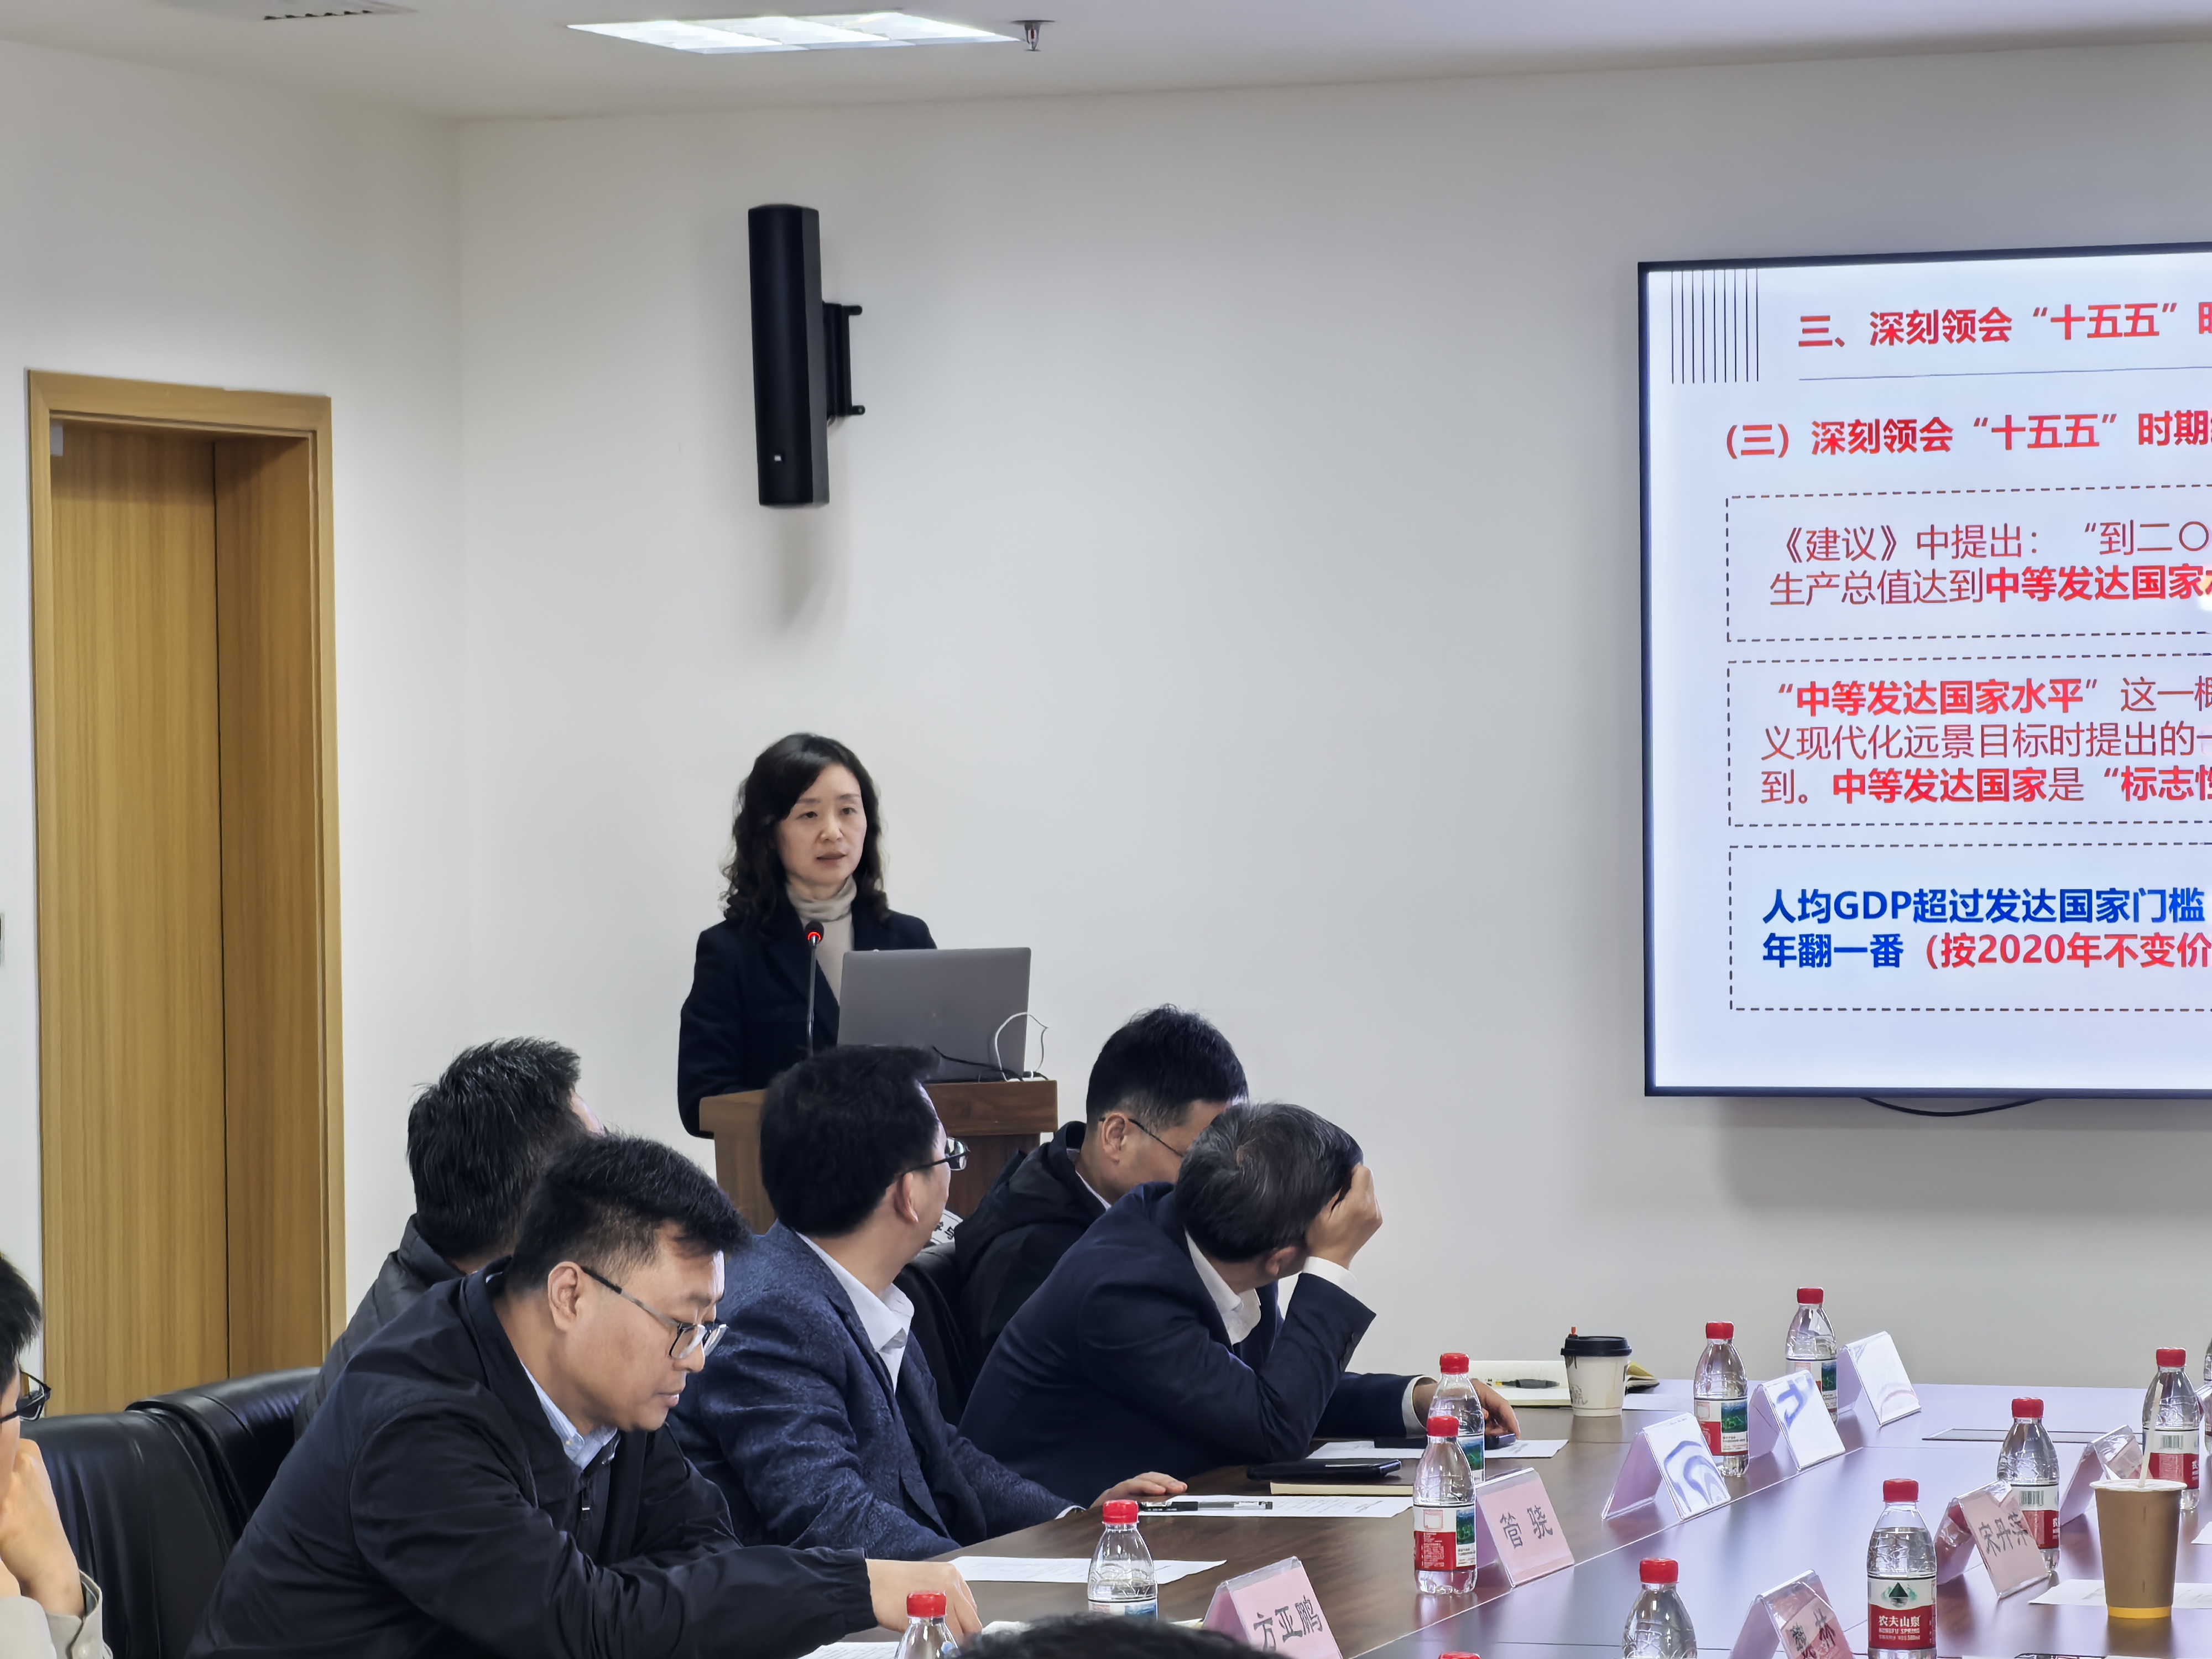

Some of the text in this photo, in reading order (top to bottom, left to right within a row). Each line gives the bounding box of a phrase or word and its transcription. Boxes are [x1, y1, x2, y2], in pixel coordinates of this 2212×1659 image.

[1726, 409, 2212, 460] （三）深刻领会“十五五”时期
[1770, 563, 2212, 606] 生产总值达到中等发达国家
[1762, 886, 2206, 924] 人均GDP超过发达国家门槛
[1253, 1594, 1323, 1652] 方亚鹏
[1878, 1615, 1921, 1627] 农夫山泉
